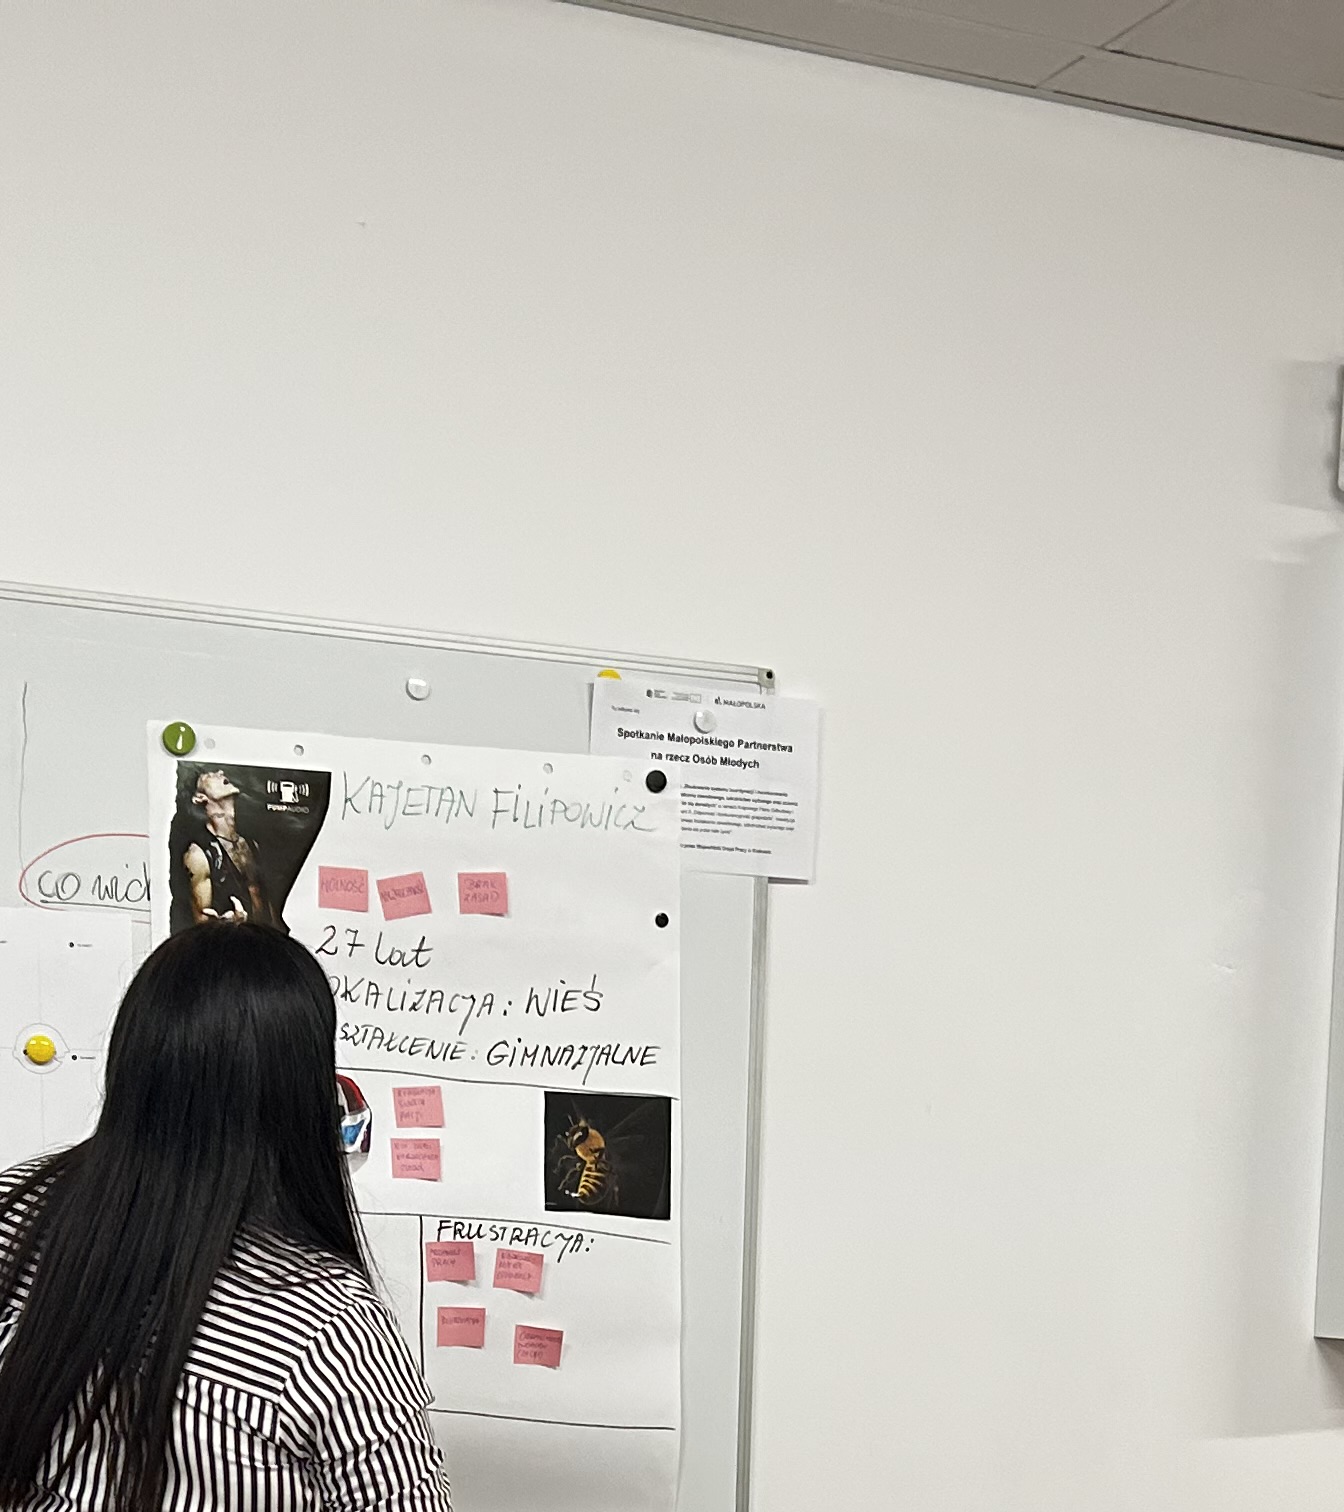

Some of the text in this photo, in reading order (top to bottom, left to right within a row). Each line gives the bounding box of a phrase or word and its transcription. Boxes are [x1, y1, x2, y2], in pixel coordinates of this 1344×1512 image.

[617, 727, 794, 753] Spotkanie Małopolskiego Partnerstwa
[650, 751, 760, 770] na rzecz Osób Młodych
[341, 771, 477, 831] KAJETAN
[315, 925, 434, 969] 27 lat
